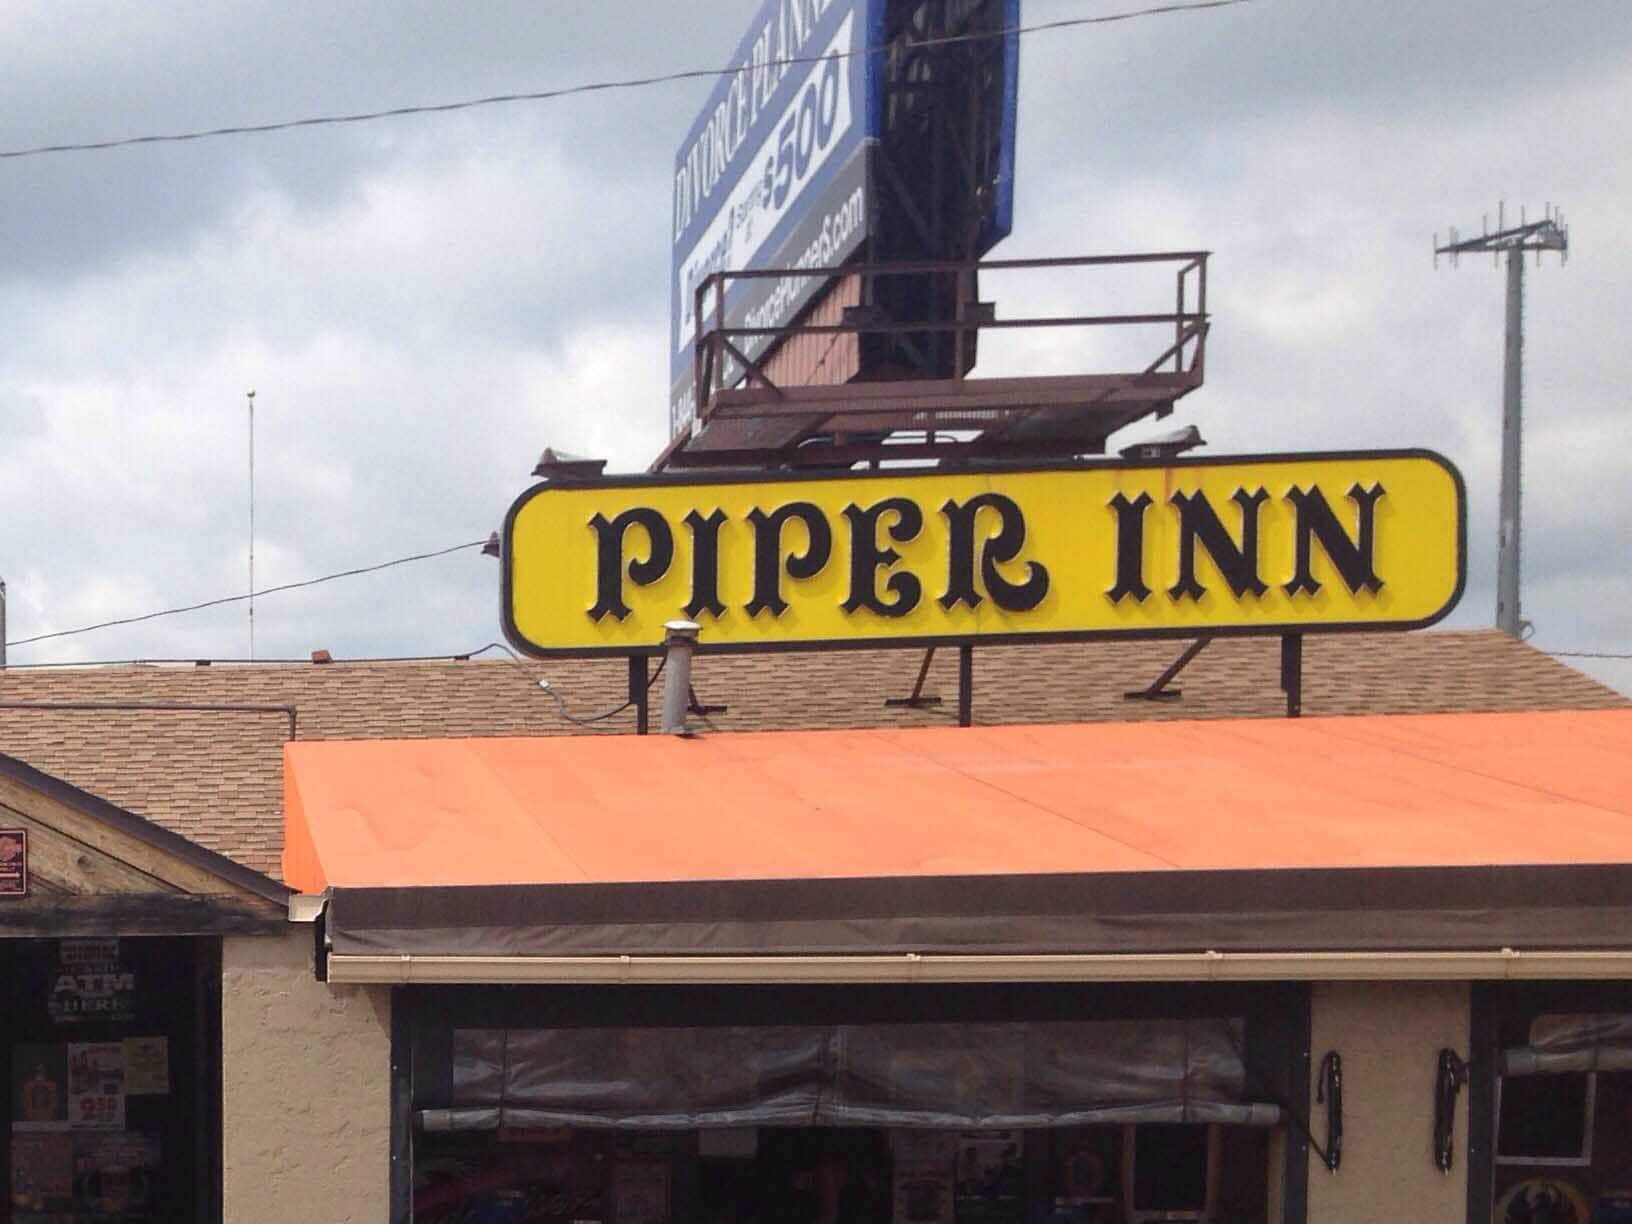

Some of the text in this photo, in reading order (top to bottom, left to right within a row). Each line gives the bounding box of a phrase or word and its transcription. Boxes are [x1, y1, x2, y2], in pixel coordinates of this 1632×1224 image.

[675, 60, 750, 243] DIVORCE
[762, 48, 840, 210] $500
[586, 481, 1386, 623] PIPER INN
[54, 974, 135, 992] ATM
